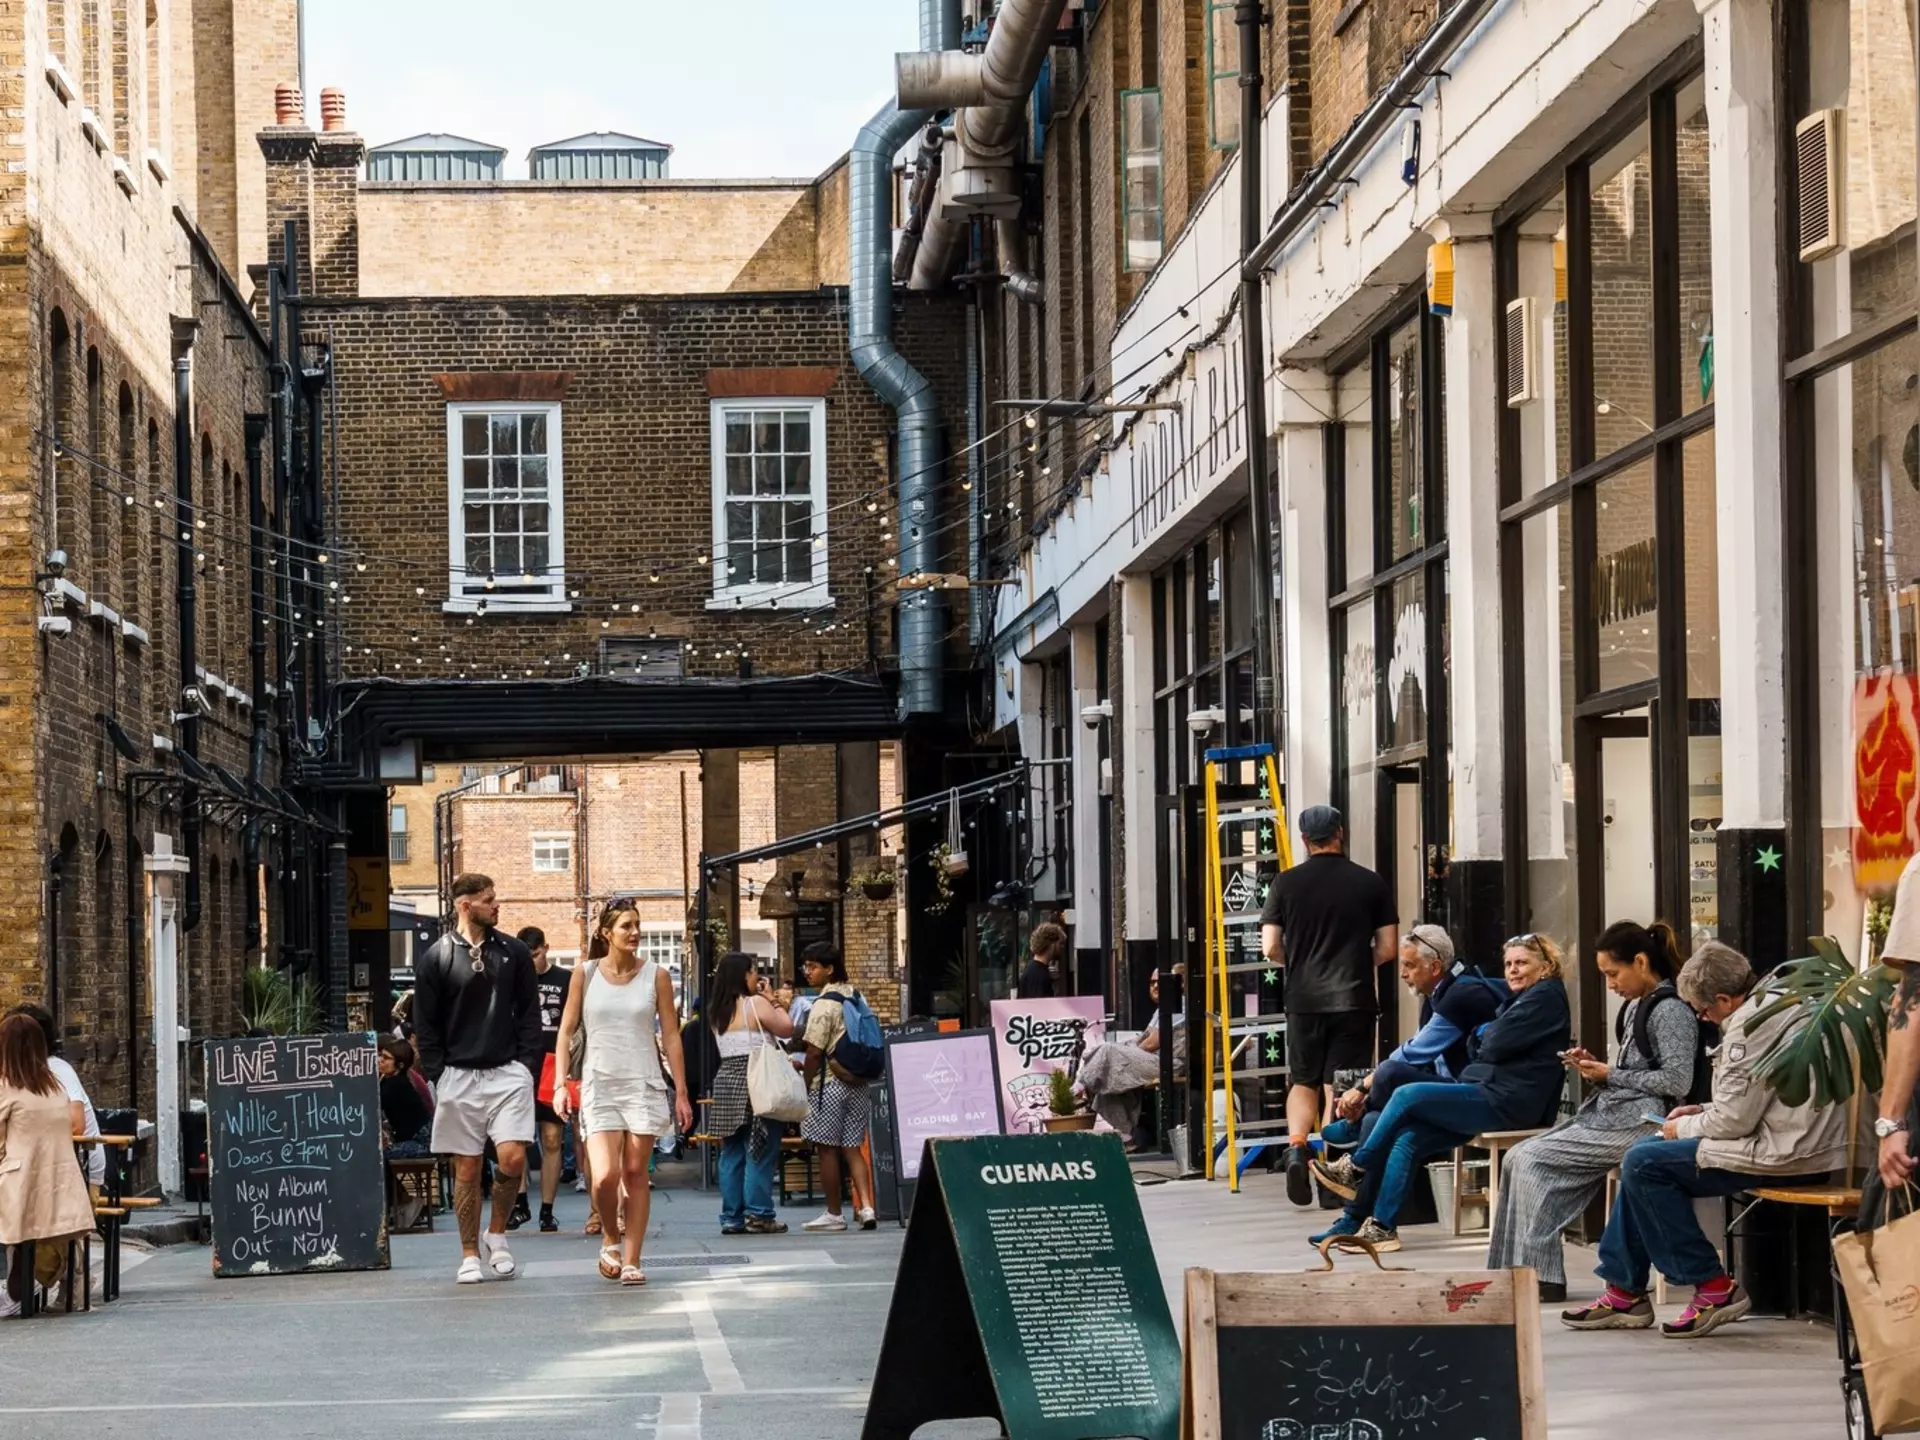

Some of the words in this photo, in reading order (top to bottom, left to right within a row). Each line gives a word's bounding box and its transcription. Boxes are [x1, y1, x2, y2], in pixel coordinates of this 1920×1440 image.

[1130, 383, 1201, 549] LOADING
[1020, 1039, 1077, 1069] Pizz
[225, 1098, 282, 1137] Willie
[306, 1092, 366, 1137] Healey
[907, 1113, 958, 1126] LOADING
[965, 1111, 987, 1121] BAY
[227, 1147, 274, 1168] Doors
[980, 1160, 1097, 1185] CUEMARS
[236, 1179, 270, 1203] New
[278, 1174, 329, 1198] Album
[250, 1202, 324, 1237] Bunny
[232, 1234, 273, 1261] Out
[293, 1233, 339, 1256] Now
